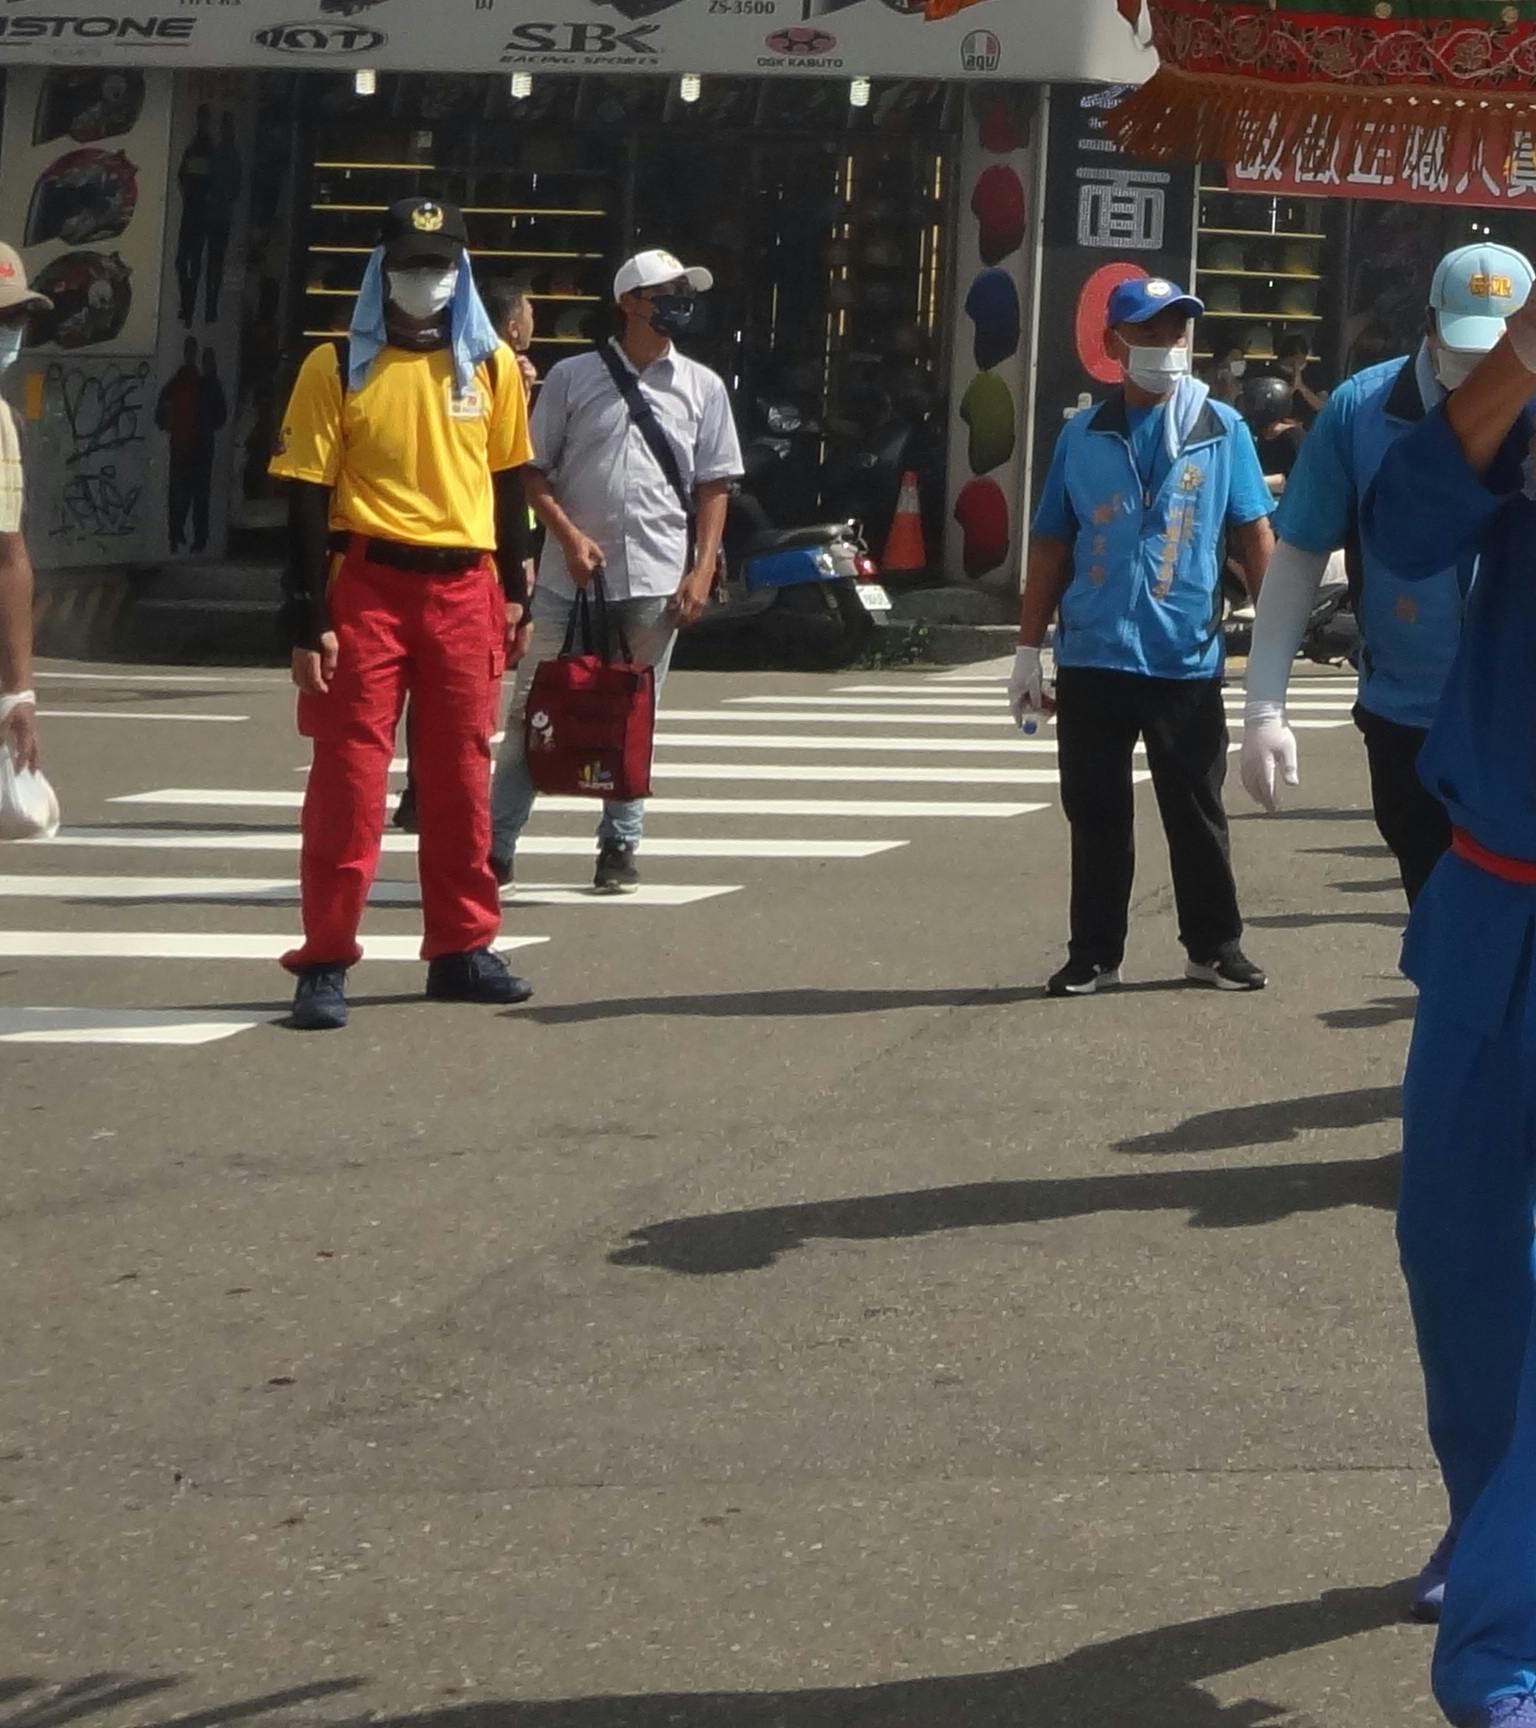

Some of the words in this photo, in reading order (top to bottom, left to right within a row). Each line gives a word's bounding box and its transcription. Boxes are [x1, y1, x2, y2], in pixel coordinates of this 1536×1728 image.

[708, 0, 776, 16] ZS-3500
[504, 22, 662, 54] SBK
[788, 58, 844, 68] KABUTO
